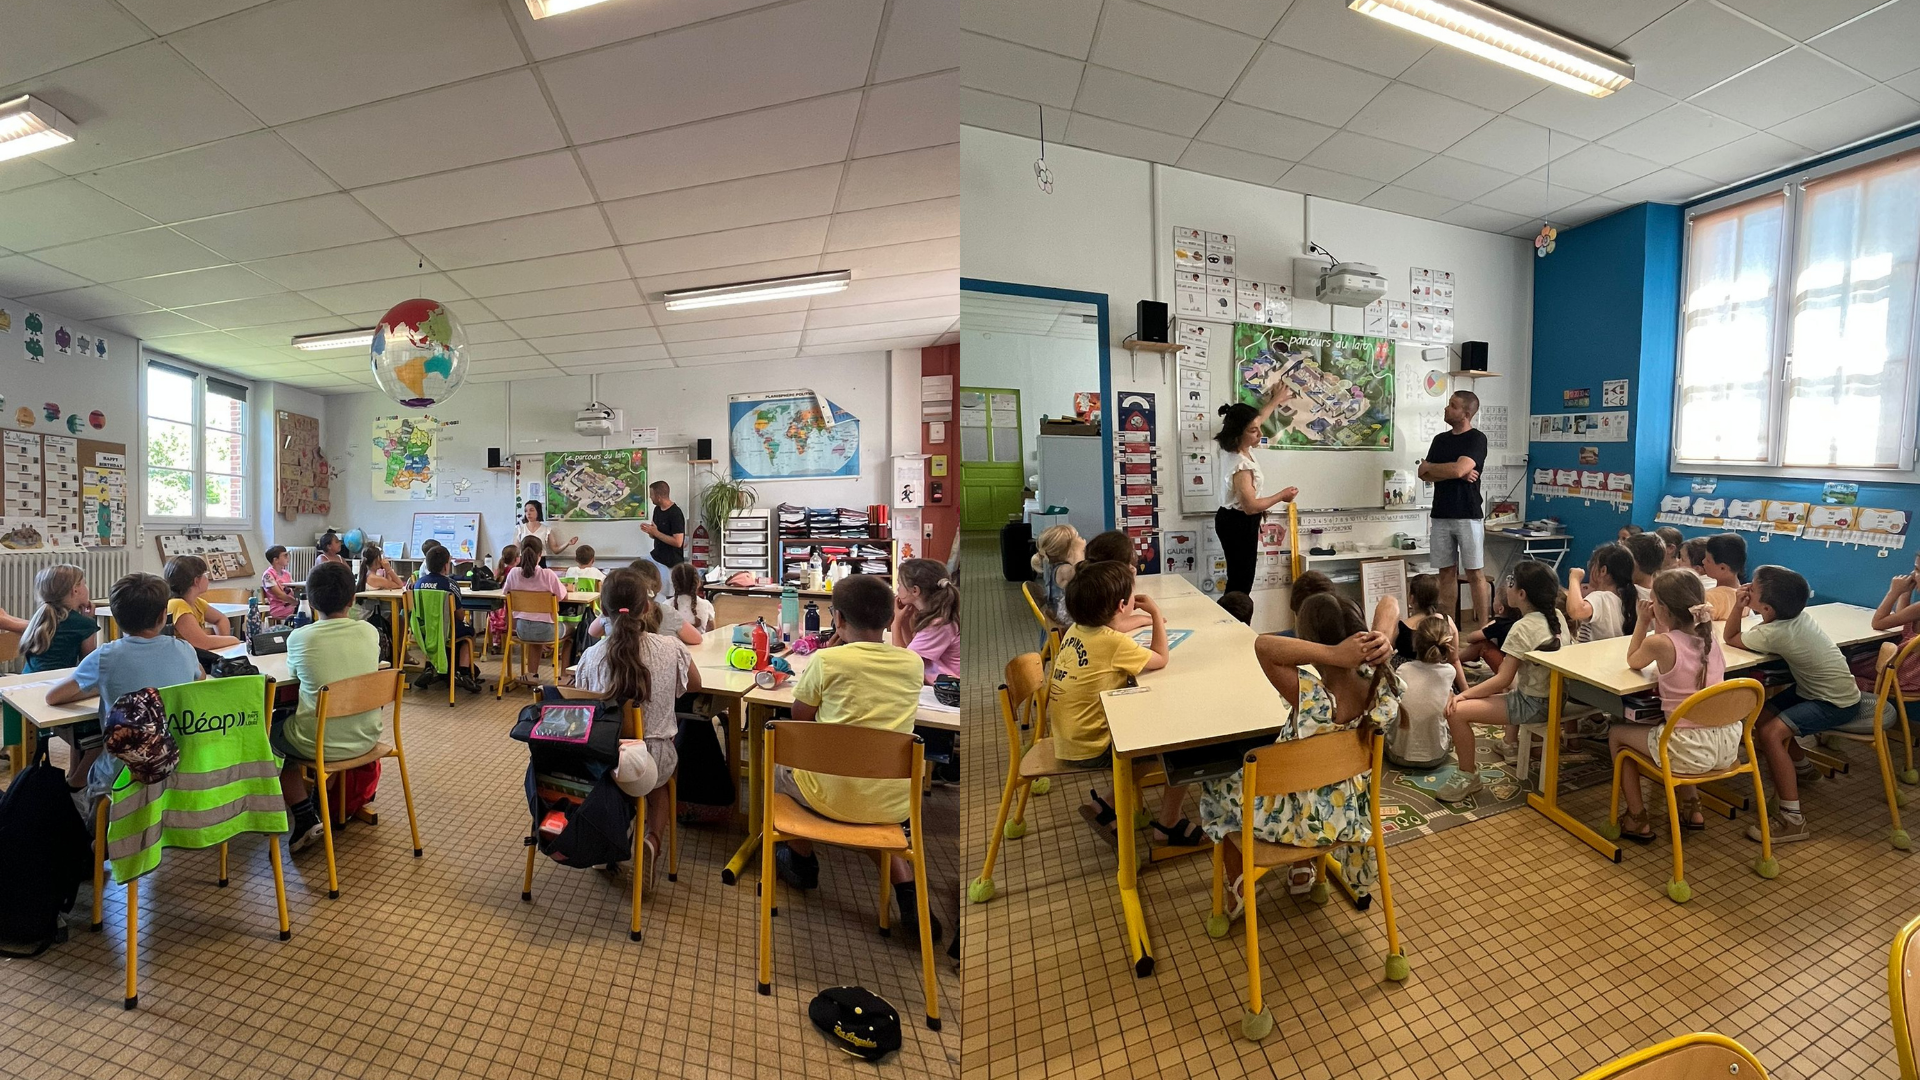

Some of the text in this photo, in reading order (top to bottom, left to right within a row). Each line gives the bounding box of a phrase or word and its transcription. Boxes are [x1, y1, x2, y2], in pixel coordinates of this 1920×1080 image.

[1270, 333, 1368, 350] Le parcours du lait
[1619, 396, 1624, 405] 6
[574, 453, 601, 461] parcours
[168, 710, 236, 736] Aléop
[846, 1032, 878, 1048] Angeles
